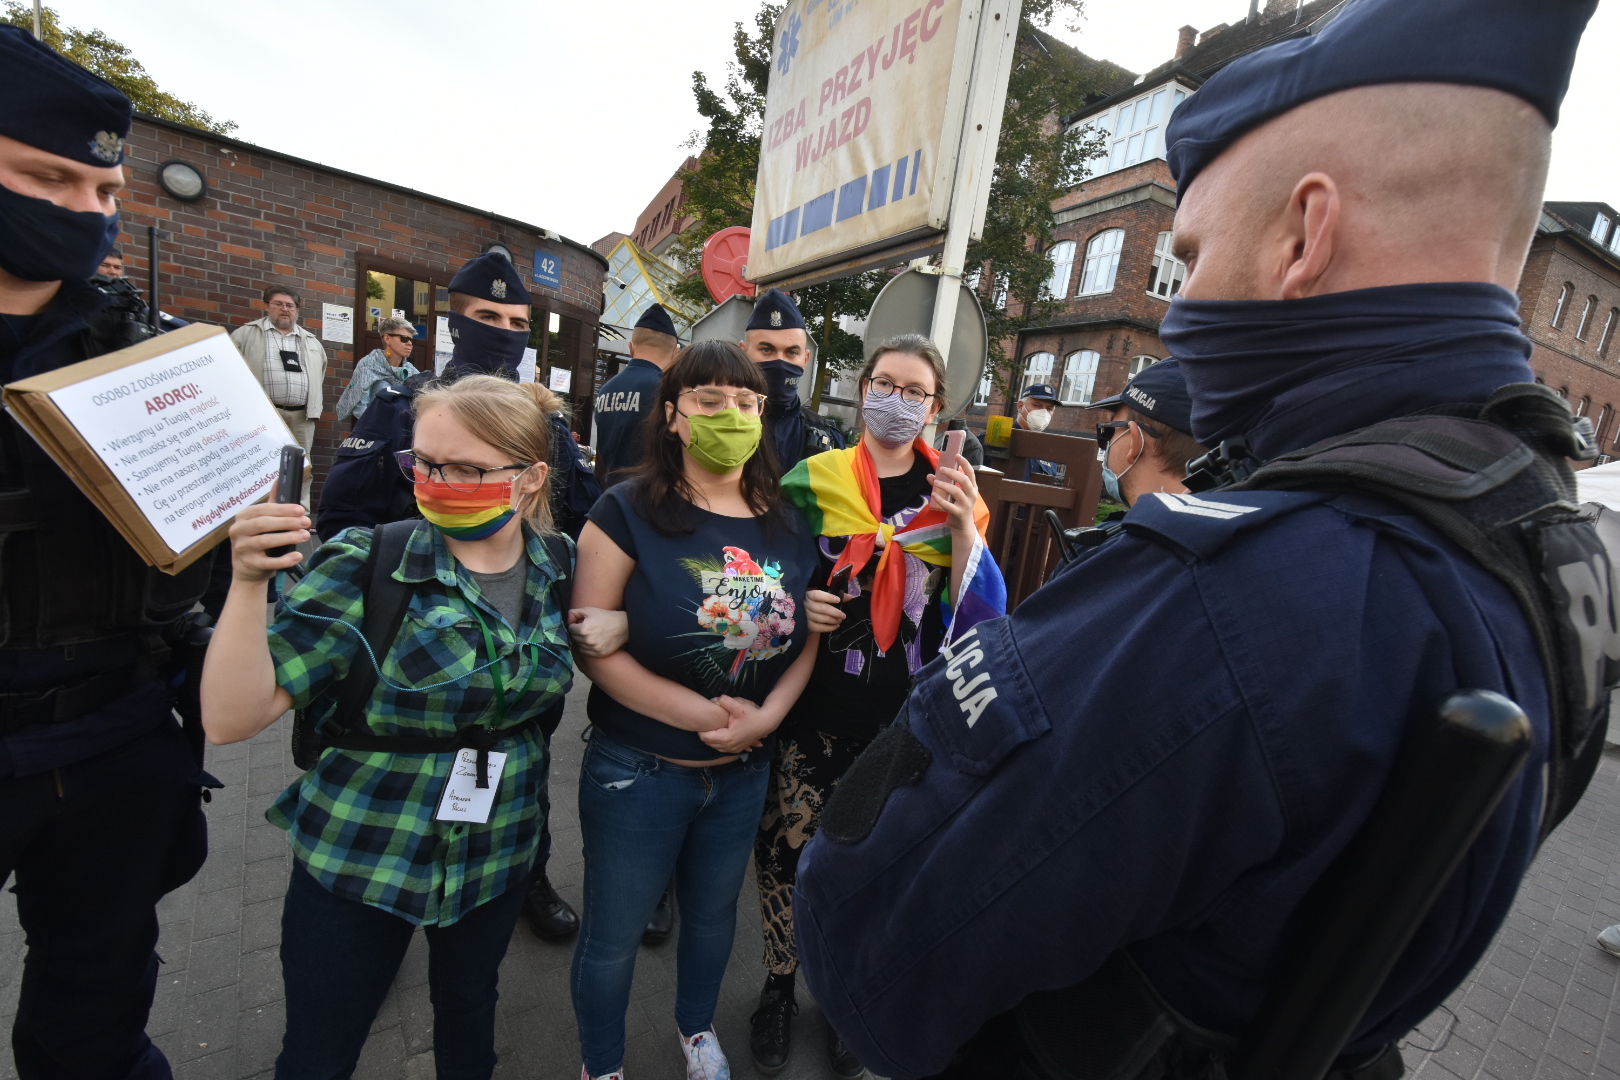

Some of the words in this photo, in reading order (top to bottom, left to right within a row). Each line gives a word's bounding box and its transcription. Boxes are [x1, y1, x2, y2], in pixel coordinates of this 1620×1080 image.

[767, 98, 806, 153] IZBA
[796, 97, 872, 172] WJAZD
[541, 257, 555, 274] 42
[92, 385, 131, 406] OSOBO
[129, 382, 139, 393] Z
[137, 354, 215, 389] DOŚWIADCZENIEM
[144, 383, 203, 415] ABORCJI:
[1126, 385, 1156, 410] POLICJA
[107, 427, 156, 451] Wierzymy
[154, 422, 164, 431] w
[162, 411, 192, 426] Twoją
[189, 395, 219, 415] mądrość
[120, 454, 138, 467] Nie
[138, 440, 167, 458] musisz
[166, 434, 181, 445] się
[179, 425, 197, 439] nam
[196, 407, 232, 430] tłumaczyć
[132, 454, 179, 481] Szanujemy
[175, 441, 204, 457] Twoją
[202, 428, 229, 446] decyzję
[143, 483, 161, 496] Nie
[160, 475, 174, 487] ma
[174, 461, 200, 479] naszej
[198, 450, 221, 467] zgody
[229, 424, 267, 451] piętnowanie
[153, 499, 171, 510] Cię
[177, 469, 216, 499] przestrzeni
[215, 453, 250, 477] publicznej
[248, 445, 261, 456] oraz
[164, 514, 176, 524] na
[174, 491, 213, 518] terroryzm
[211, 474, 242, 496] religijny
[240, 456, 271, 478] względem
[191, 468, 280, 530] #NigdyNieBędzieszSzłaSam
[709, 578, 776, 612] Enjoy
